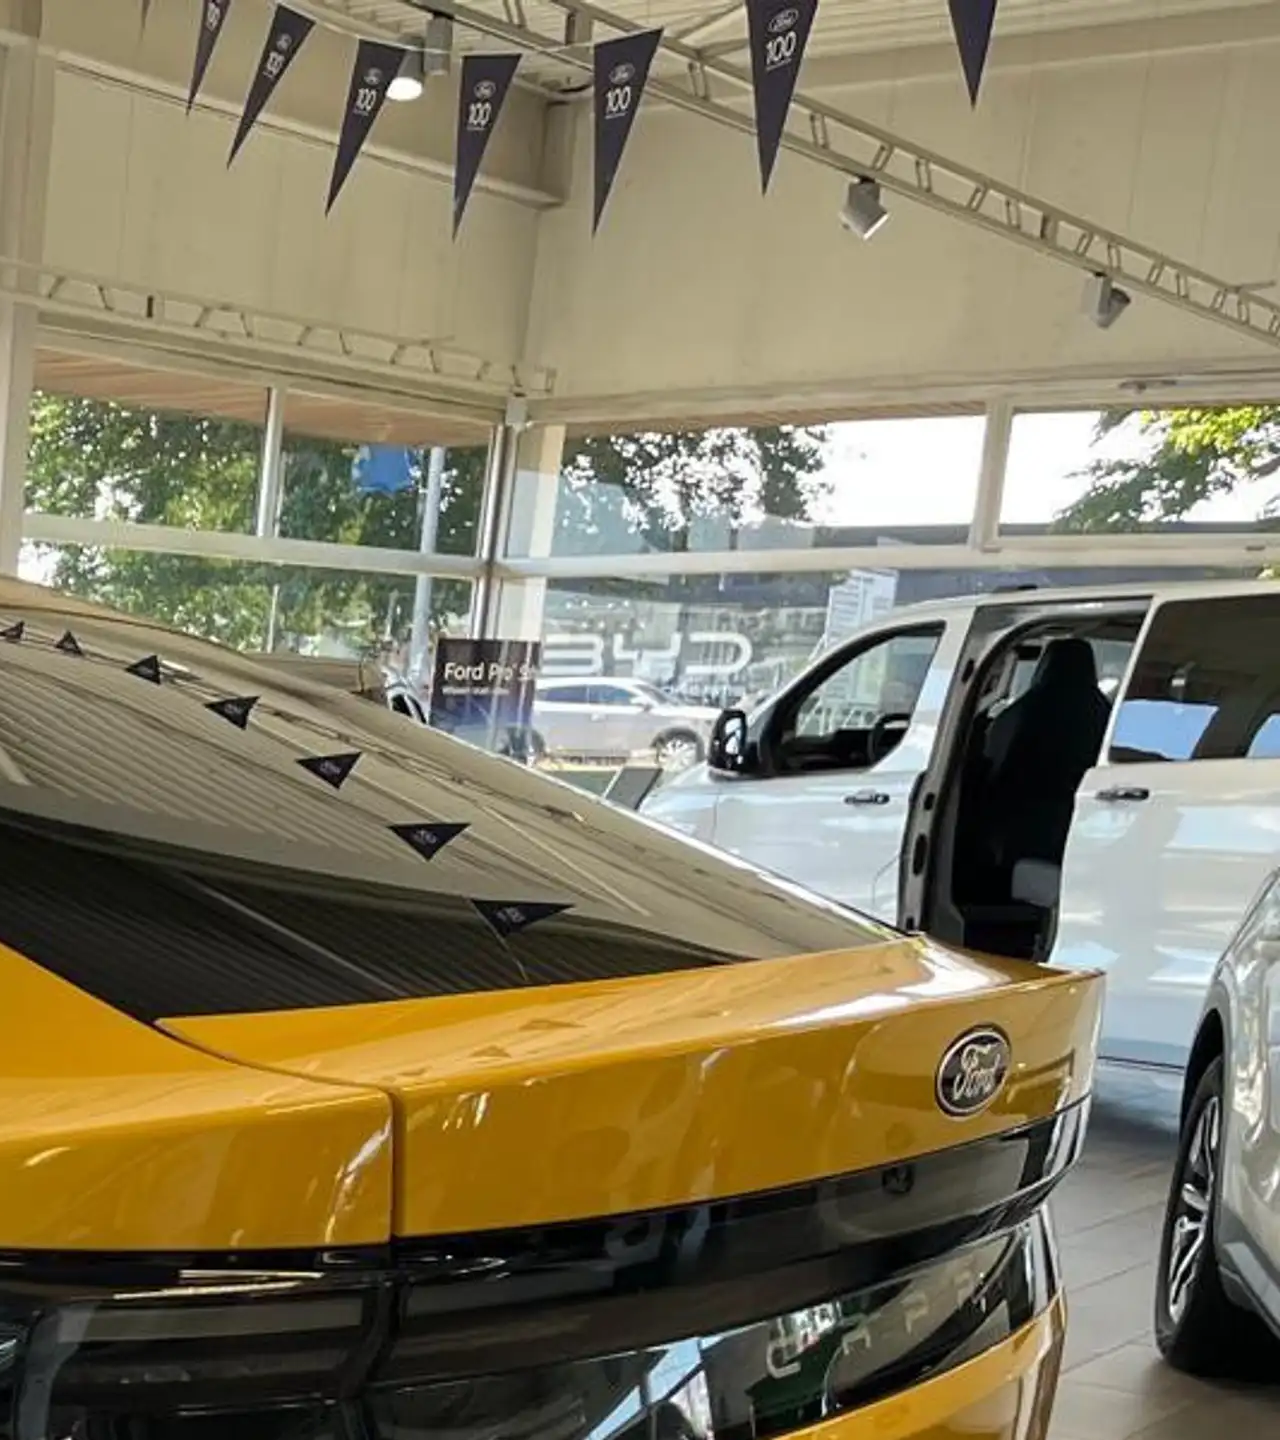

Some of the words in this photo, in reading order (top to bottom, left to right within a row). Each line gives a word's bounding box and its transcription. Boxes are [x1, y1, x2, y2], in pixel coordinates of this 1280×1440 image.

[765, 31, 796, 65] 100
[356, 87, 377, 111] 100
[605, 86, 632, 112] 100
[468, 102, 492, 126] 100
[541, 631, 753, 676] BYD
[445, 662, 485, 681] Ford
